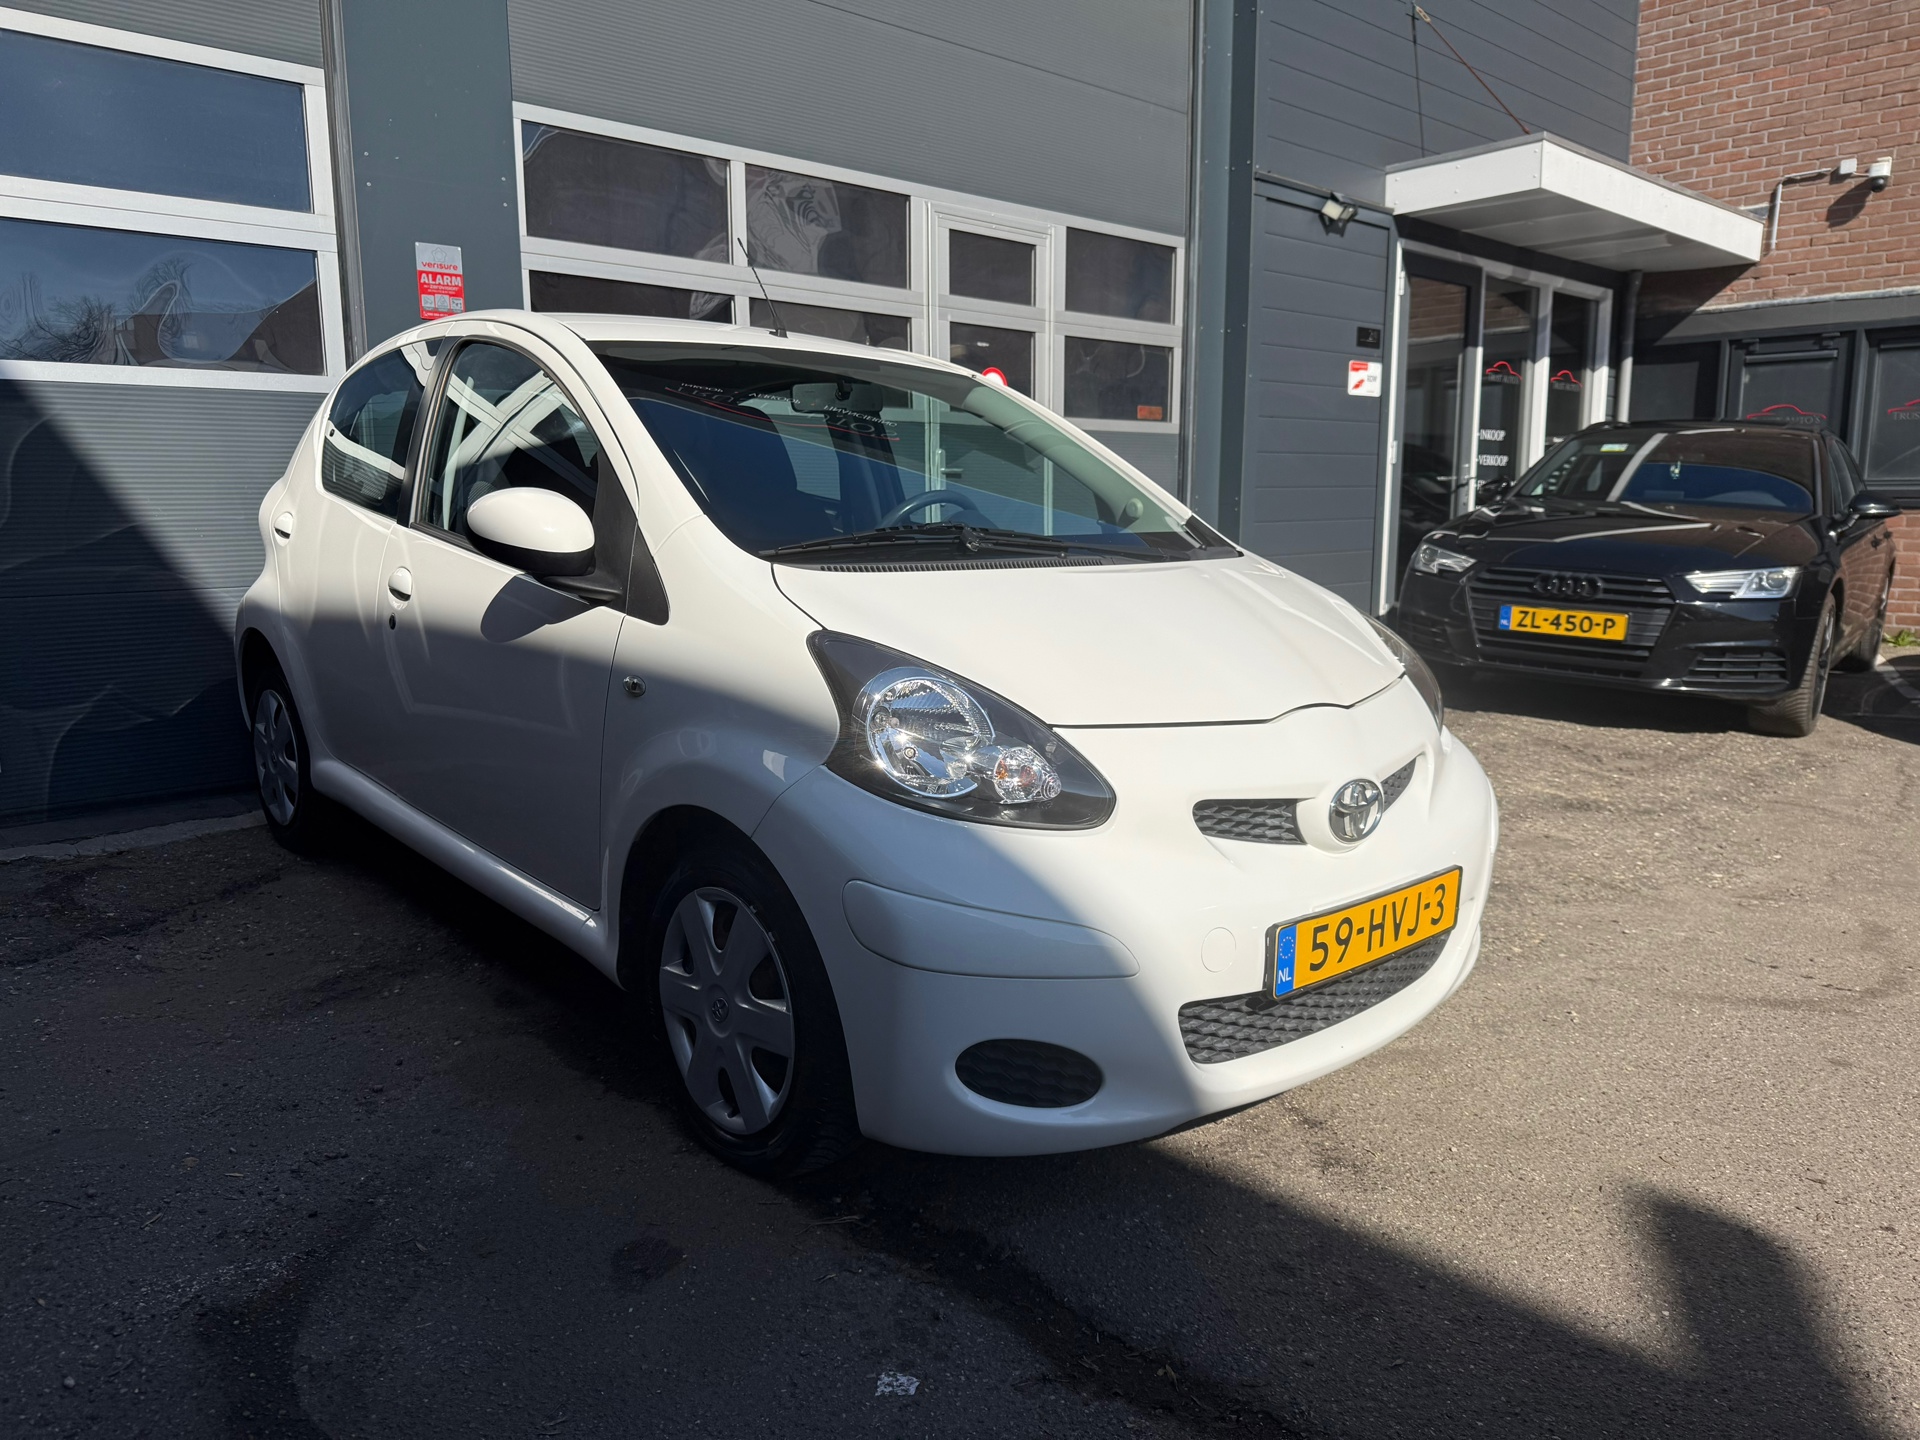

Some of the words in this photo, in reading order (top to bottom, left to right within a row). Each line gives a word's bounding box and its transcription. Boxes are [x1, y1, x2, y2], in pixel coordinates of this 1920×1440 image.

[421, 261, 459, 271] verisure
[420, 273, 462, 287] ALARM
[1479, 429, 1507, 441] INKOOP
[1478, 453, 1510, 466] VERKOOP
[1500, 618, 1510, 626] NL
[1516, 610, 1617, 636] ZL-450-P
[1309, 883, 1447, 972] 59-HVJ-3
[1278, 967, 1292, 984] NL
